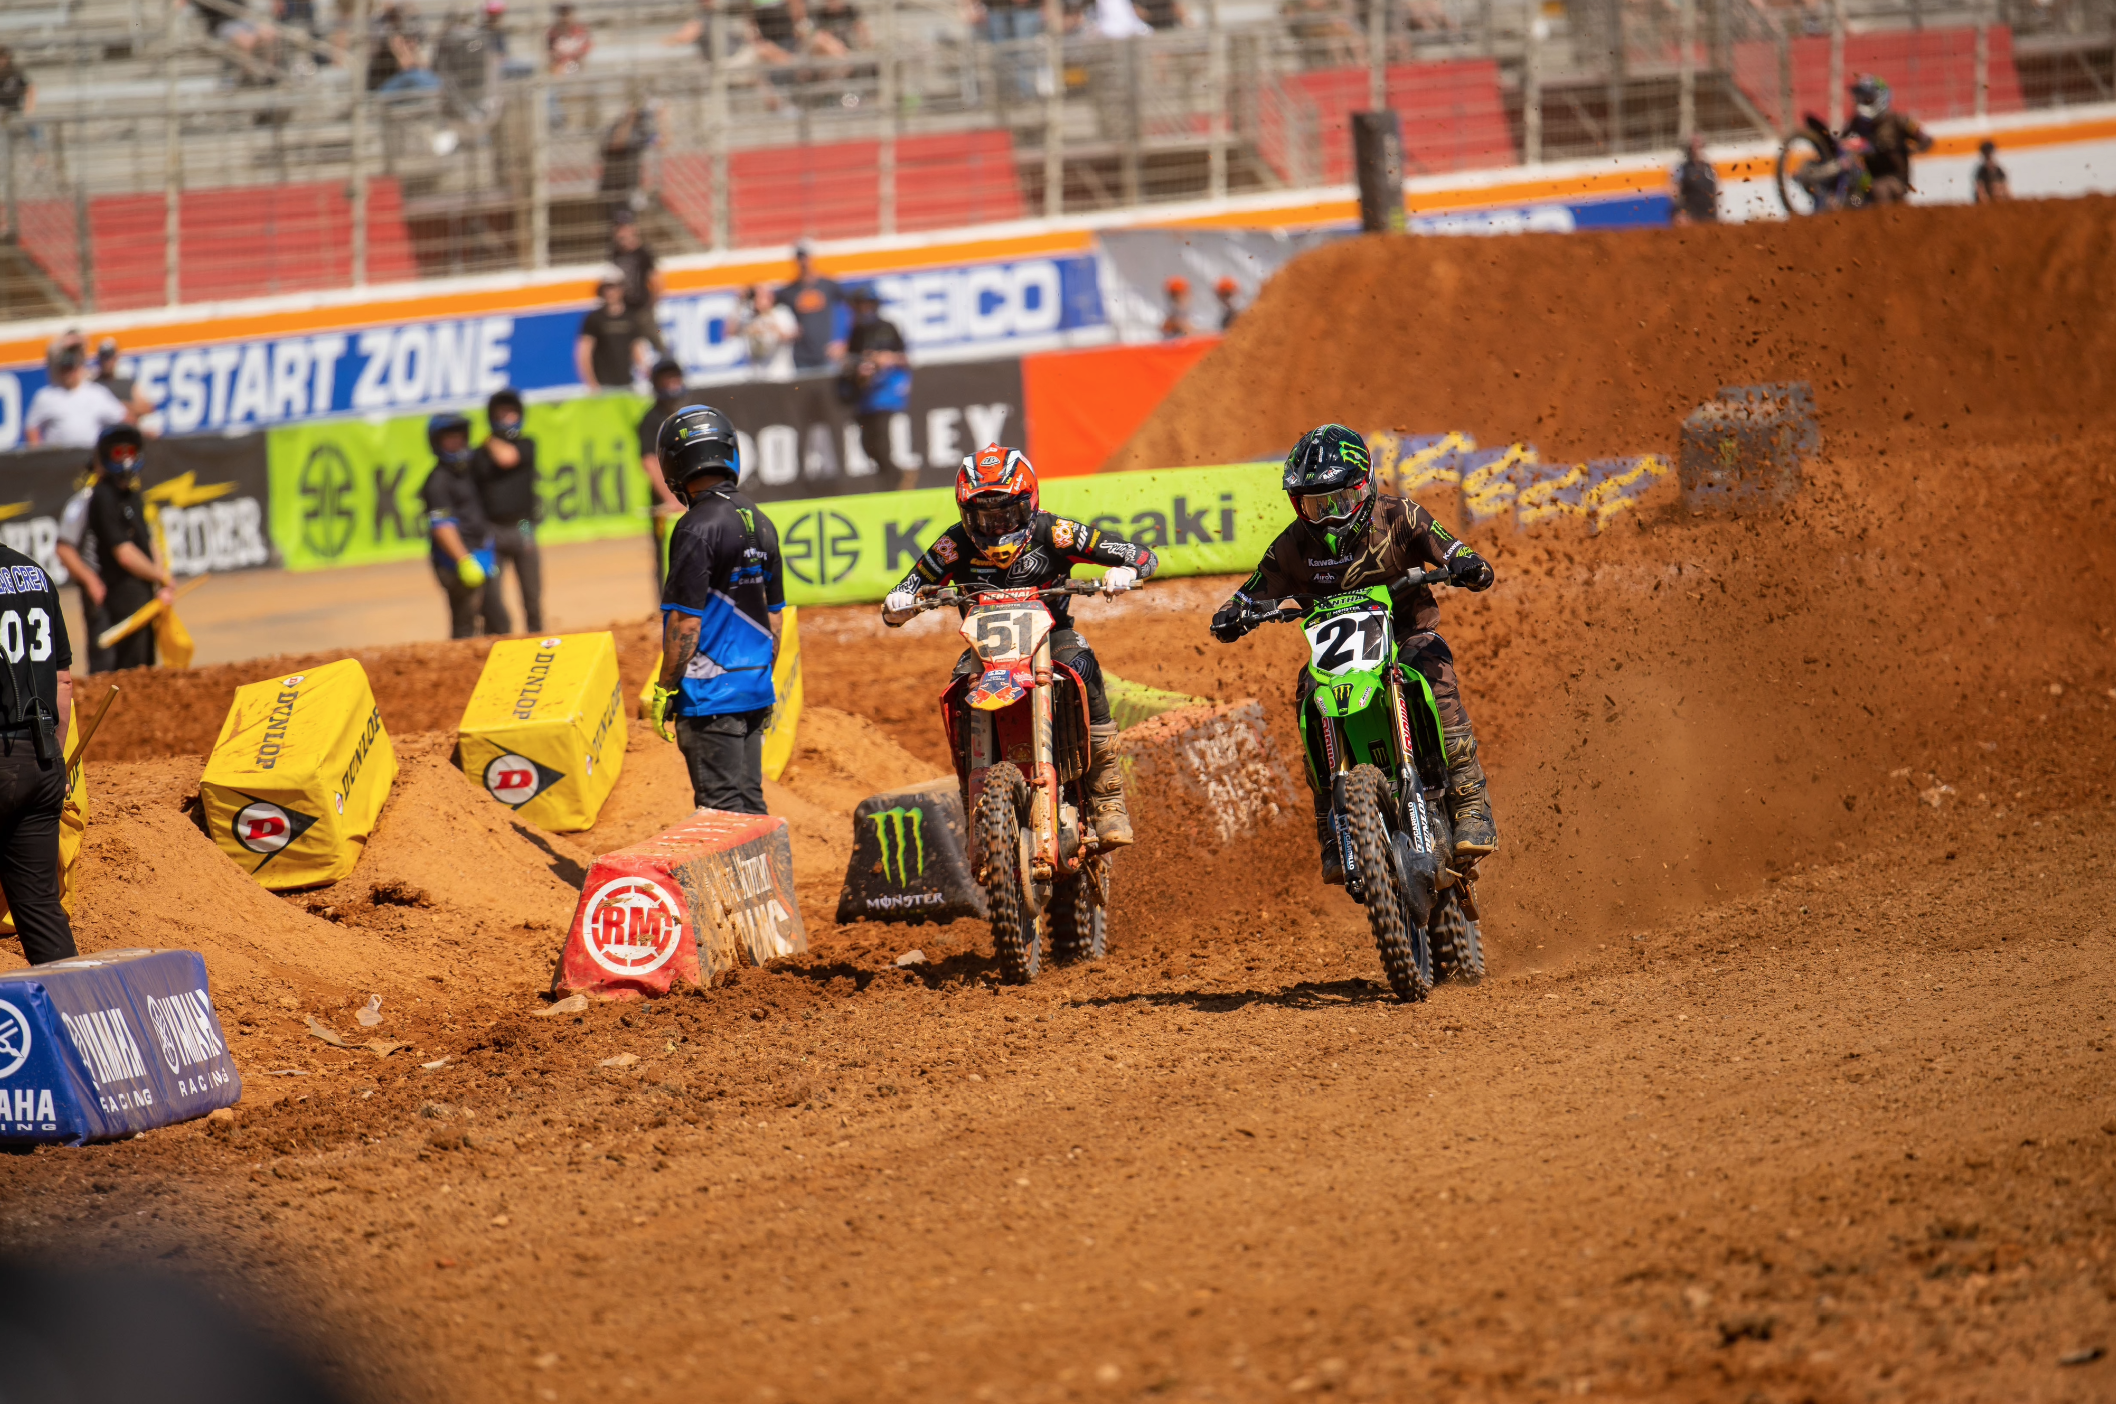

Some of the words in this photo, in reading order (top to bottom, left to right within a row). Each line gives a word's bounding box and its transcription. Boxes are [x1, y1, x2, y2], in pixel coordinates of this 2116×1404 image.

[113, 335, 347, 437] ESTART
[352, 314, 514, 404] ZONE
[977, 612, 1033, 658] 51
[1316, 614, 1385, 672] 21
[513, 652, 556, 721] DUNLOP
[255, 691, 299, 770] DUNLOP
[600, 906, 664, 947] RM
[866, 892, 944, 909] MONSTER
[178, 1067, 230, 1097] RACING
